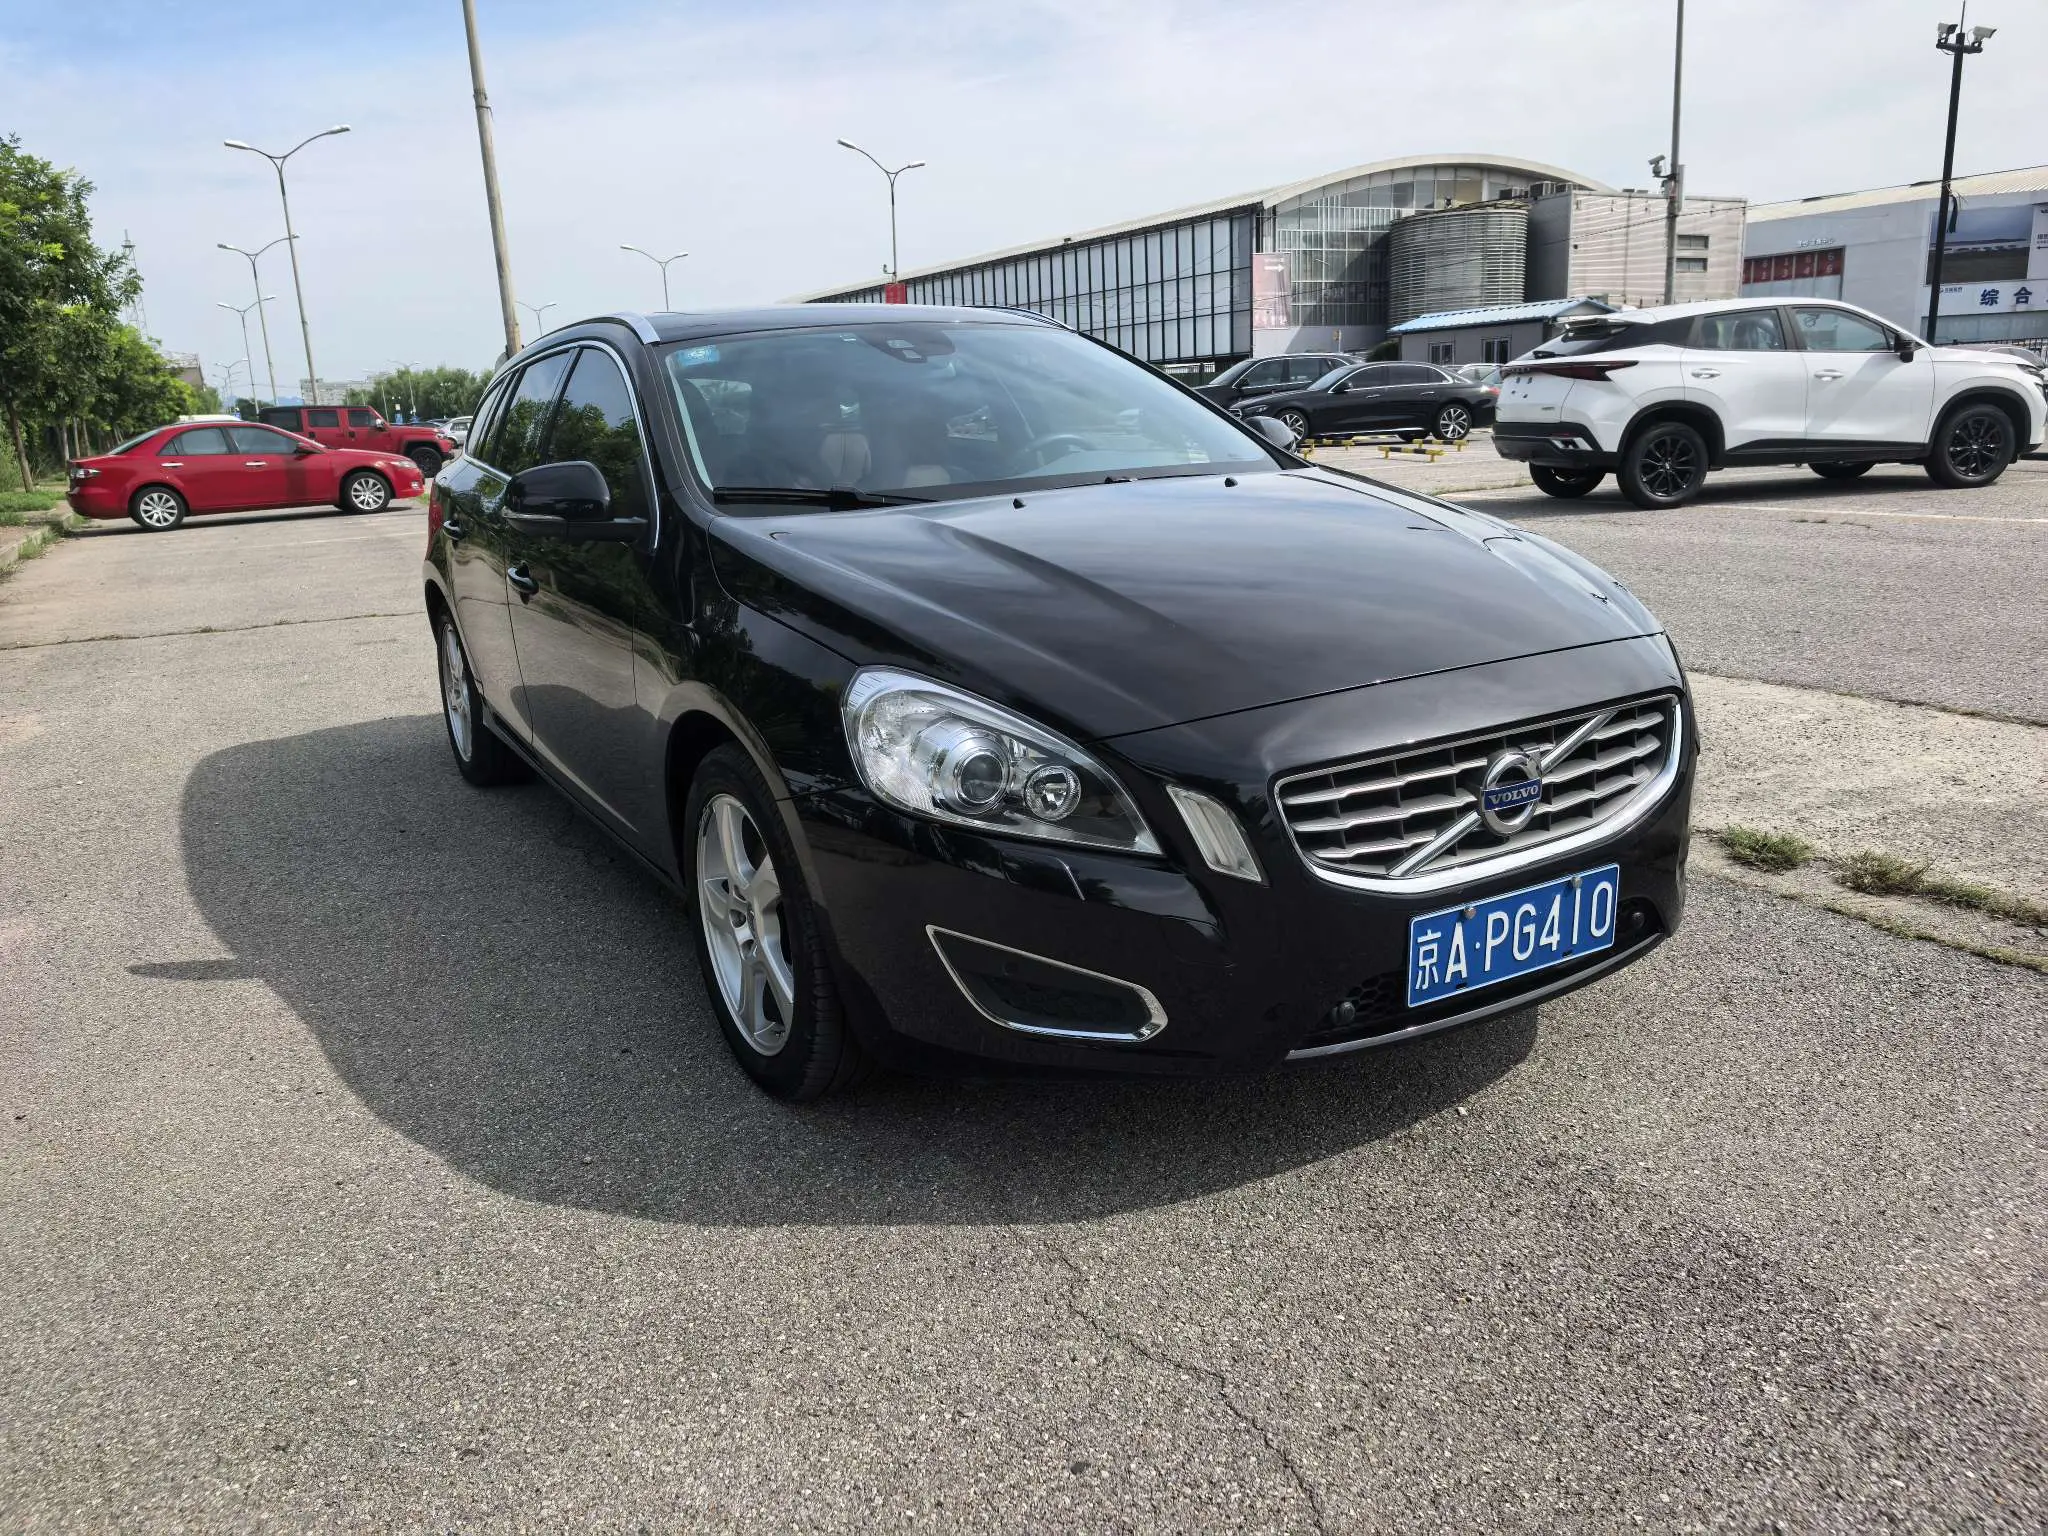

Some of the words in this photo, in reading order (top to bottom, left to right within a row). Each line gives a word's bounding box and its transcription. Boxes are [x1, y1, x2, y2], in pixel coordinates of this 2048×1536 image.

[1980, 286, 2048, 306] 综合
[1488, 785, 1539, 805] VOLVO
[1415, 881, 1613, 991] 京A·PG410
